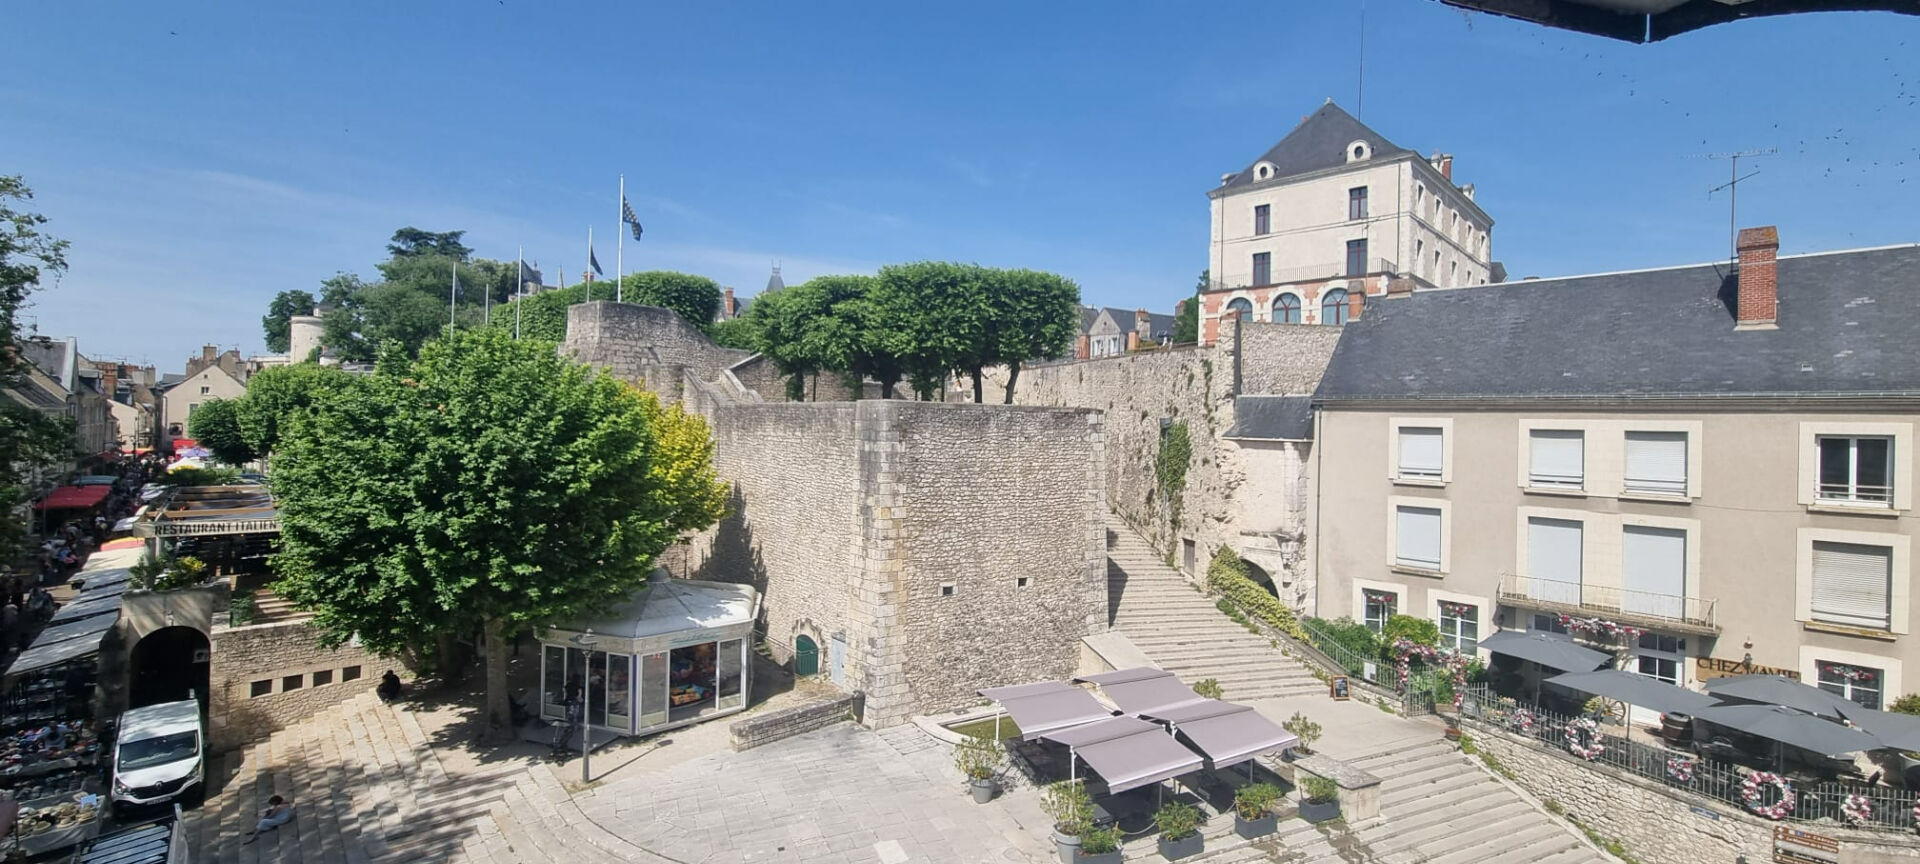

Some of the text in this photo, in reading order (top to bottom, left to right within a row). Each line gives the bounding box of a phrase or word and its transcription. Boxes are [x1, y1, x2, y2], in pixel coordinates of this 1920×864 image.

[154, 520, 277, 535] RESTAURANT ITALIEN
[1696, 657, 1743, 674] CHEZ
